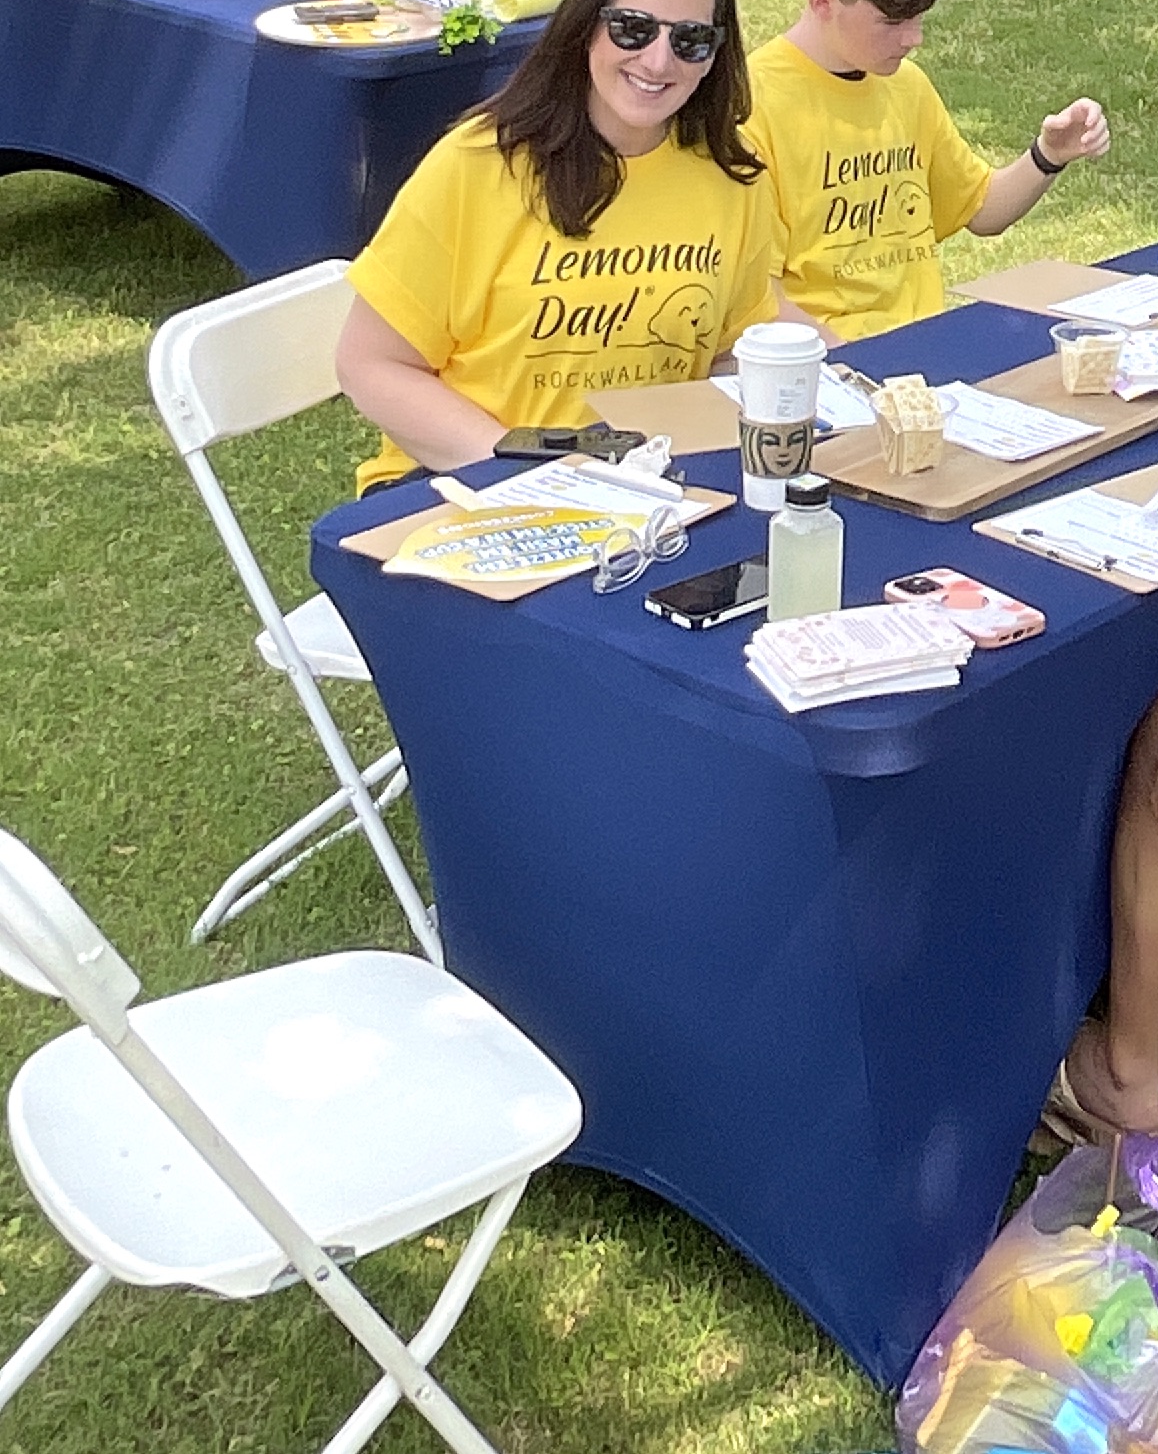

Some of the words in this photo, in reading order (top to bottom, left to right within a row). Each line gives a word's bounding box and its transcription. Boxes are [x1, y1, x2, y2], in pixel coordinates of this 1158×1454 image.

[823, 184, 889, 237] Day!
[531, 233, 722, 286] Lemonade
[530, 286, 640, 348] Day!
